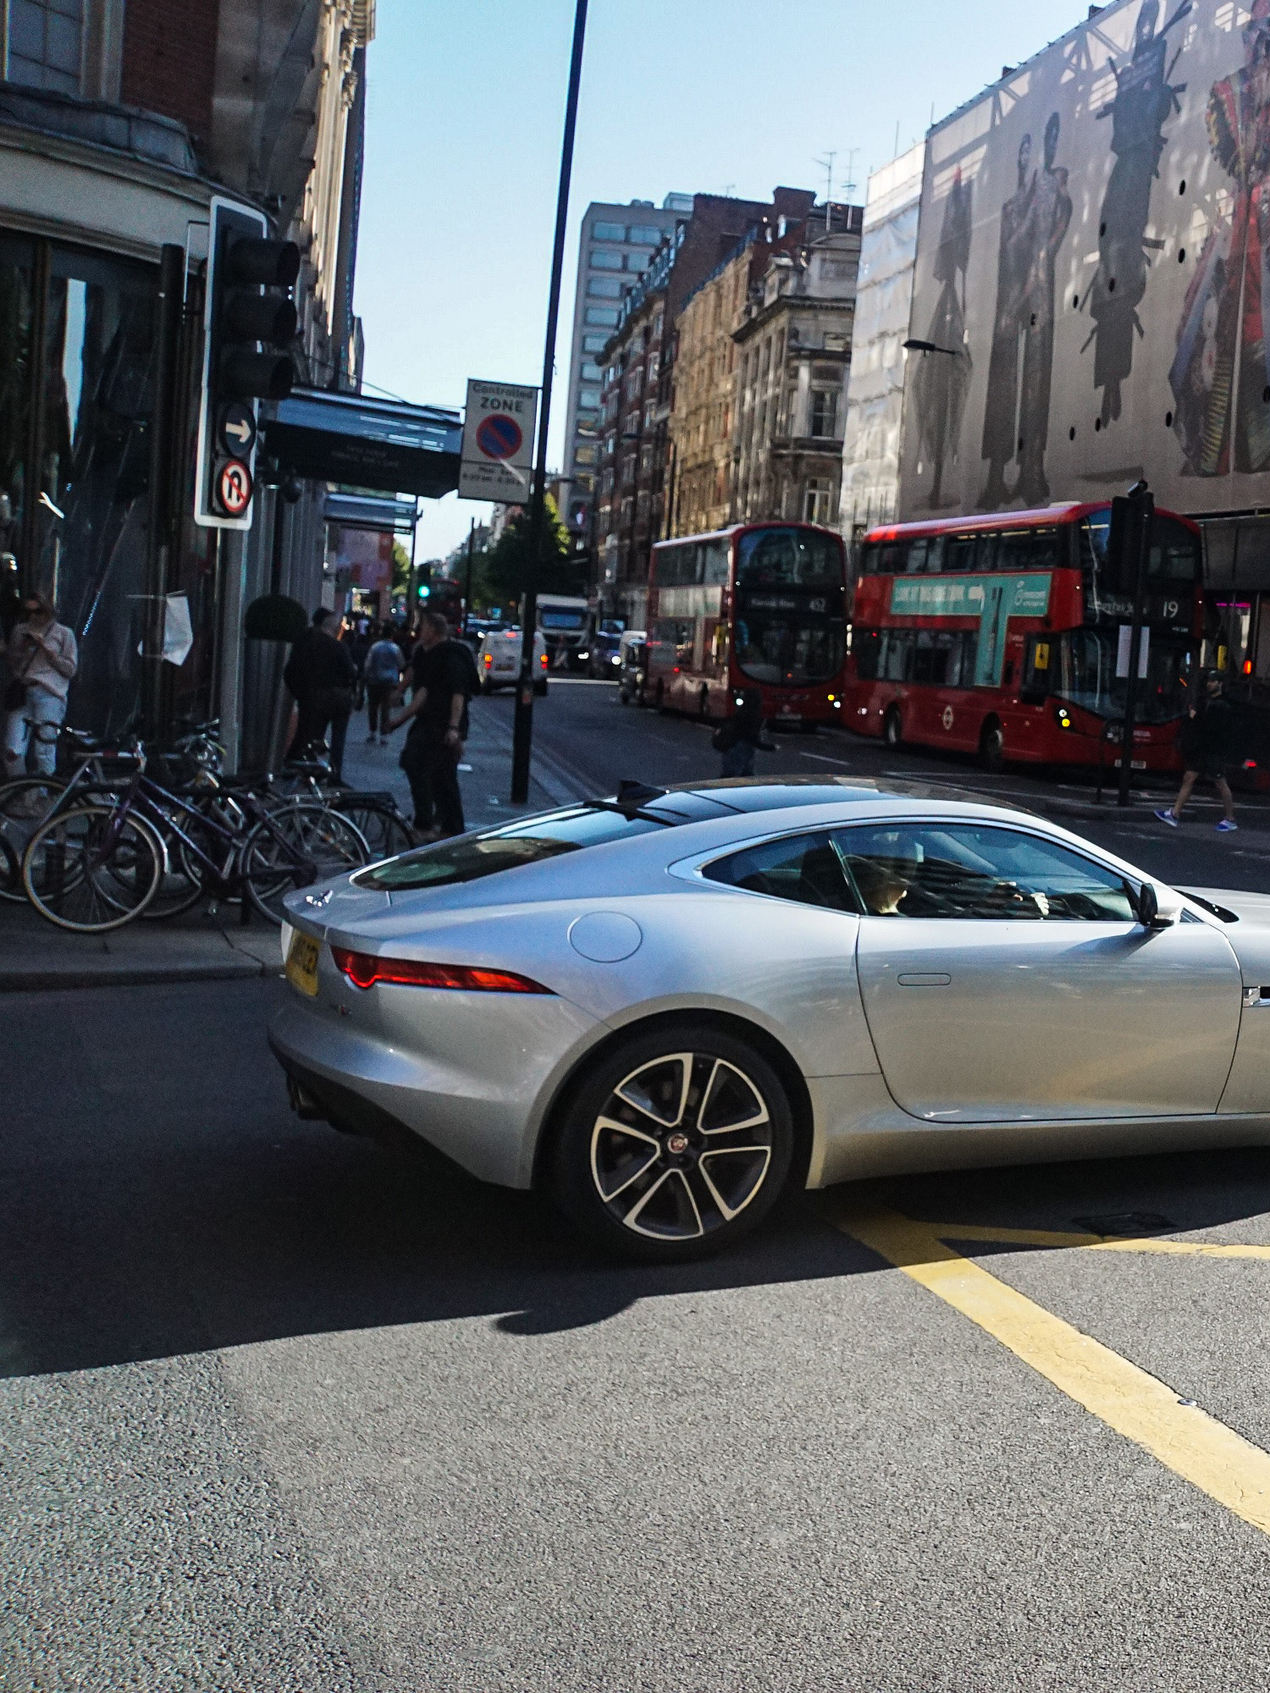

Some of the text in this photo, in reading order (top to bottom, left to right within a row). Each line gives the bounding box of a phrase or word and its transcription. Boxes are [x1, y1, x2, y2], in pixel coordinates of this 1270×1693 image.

[472, 383, 534, 399] Controlled
[480, 397, 523, 412] ZONE
[1162, 600, 1179, 618] 19
